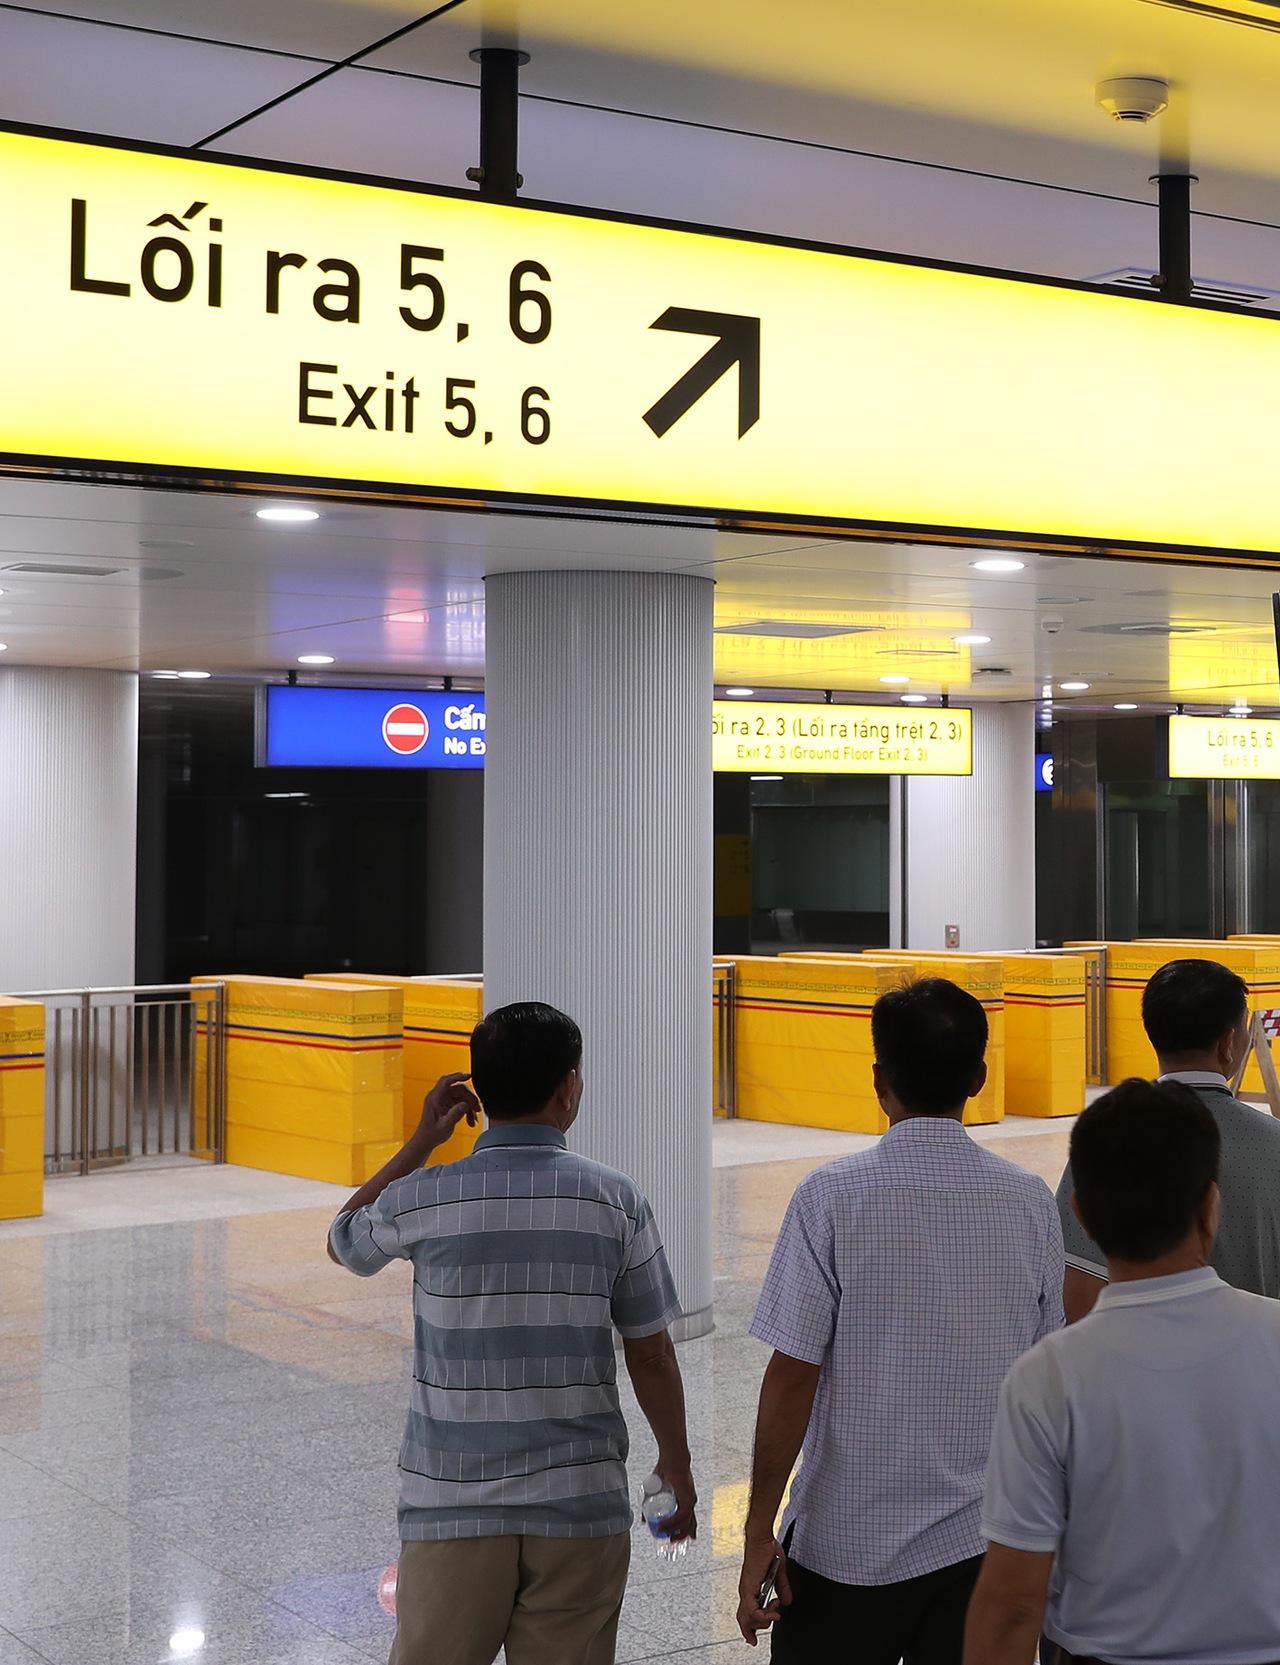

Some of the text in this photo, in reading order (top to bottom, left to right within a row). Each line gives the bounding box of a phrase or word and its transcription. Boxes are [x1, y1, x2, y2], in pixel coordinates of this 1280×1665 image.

[70, 198, 552, 345] Lối ra 5, 6
[298, 361, 551, 445] Exit 5, 6
[712, 713, 724, 735] ối
[731, 721, 749, 736] ra
[776, 717, 786, 737] 3
[830, 724, 847, 739] ra
[854, 717, 889, 744] tầng
[896, 721, 923, 744] trệt
[948, 721, 962, 742] 3)
[1233, 735, 1246, 748] ra
[1265, 731, 1273, 748] 6
[443, 736, 467, 755] No
[737, 744, 760, 759] Exit
[779, 745, 786, 760] 3
[790, 744, 840, 761] (Ground
[844, 746, 875, 761] Floor
[879, 747, 900, 761] Exit
